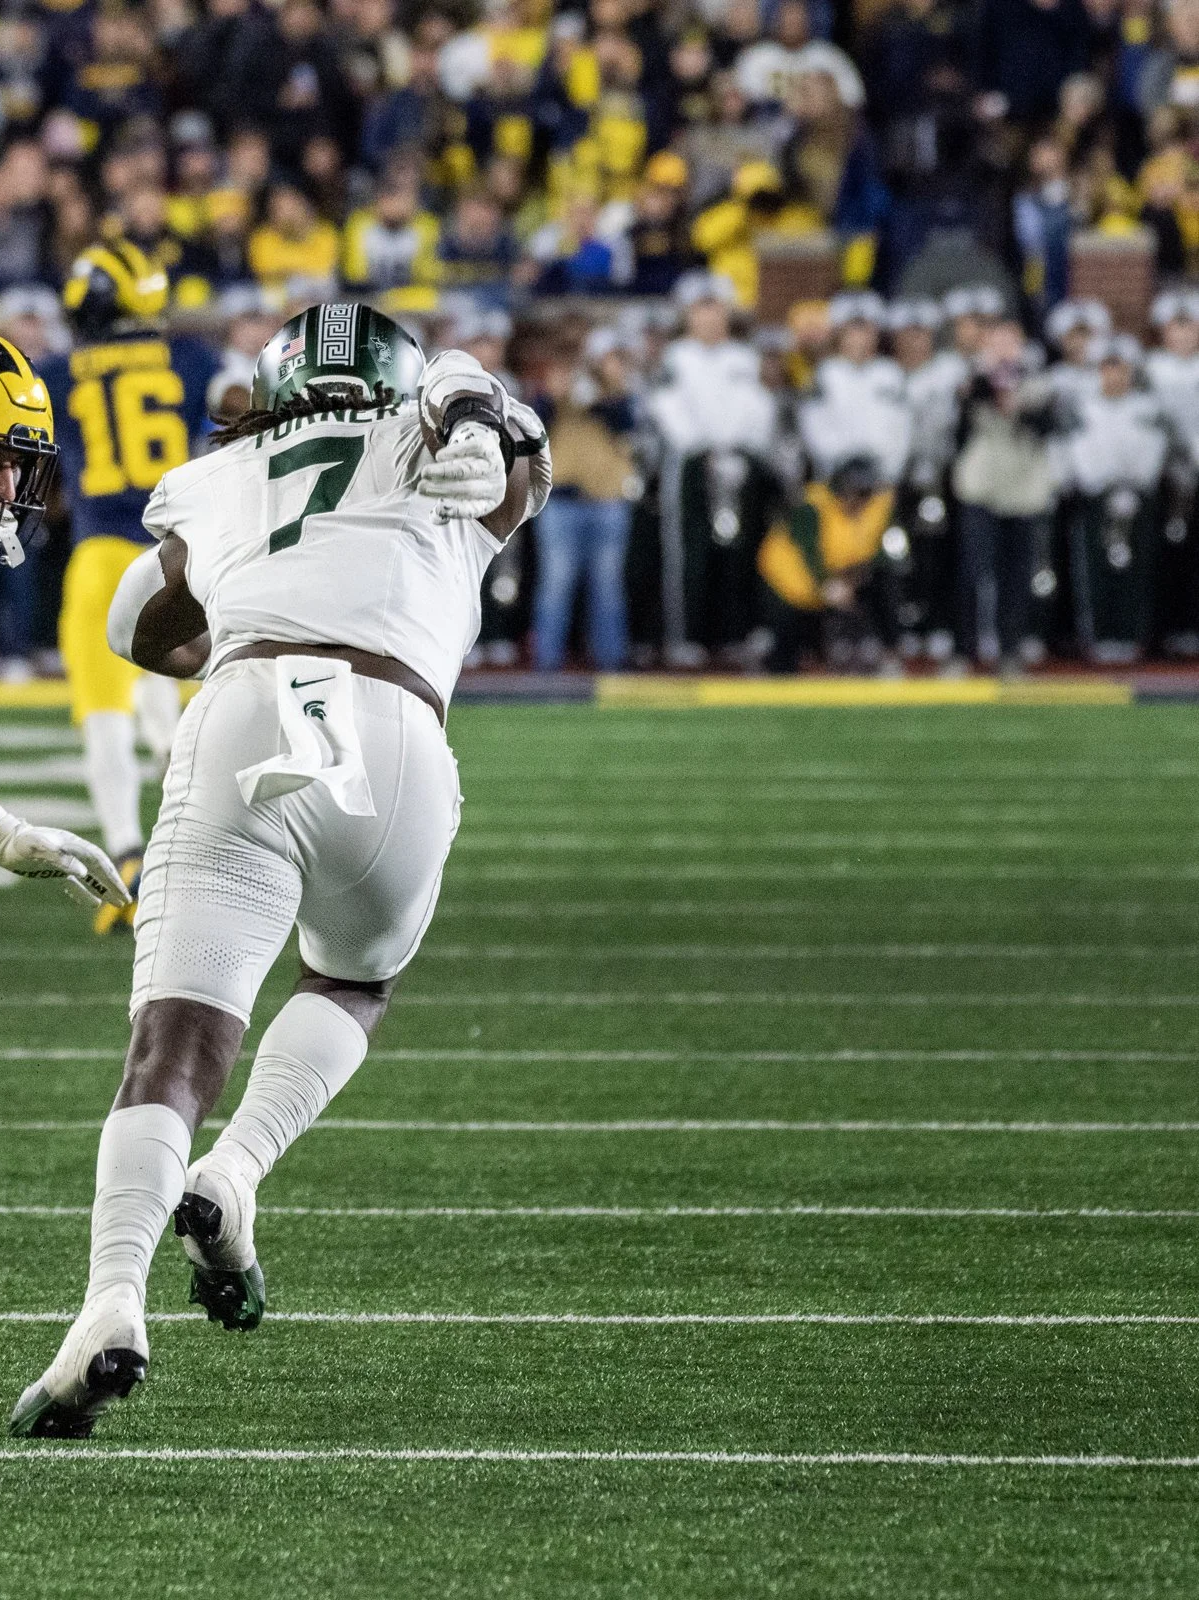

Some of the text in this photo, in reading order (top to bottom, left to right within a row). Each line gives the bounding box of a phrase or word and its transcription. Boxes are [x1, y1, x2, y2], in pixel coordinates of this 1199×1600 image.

[68, 370, 188, 497] 16
[268, 435, 365, 556] 7
[13, 869, 108, 895] MIIGAN
